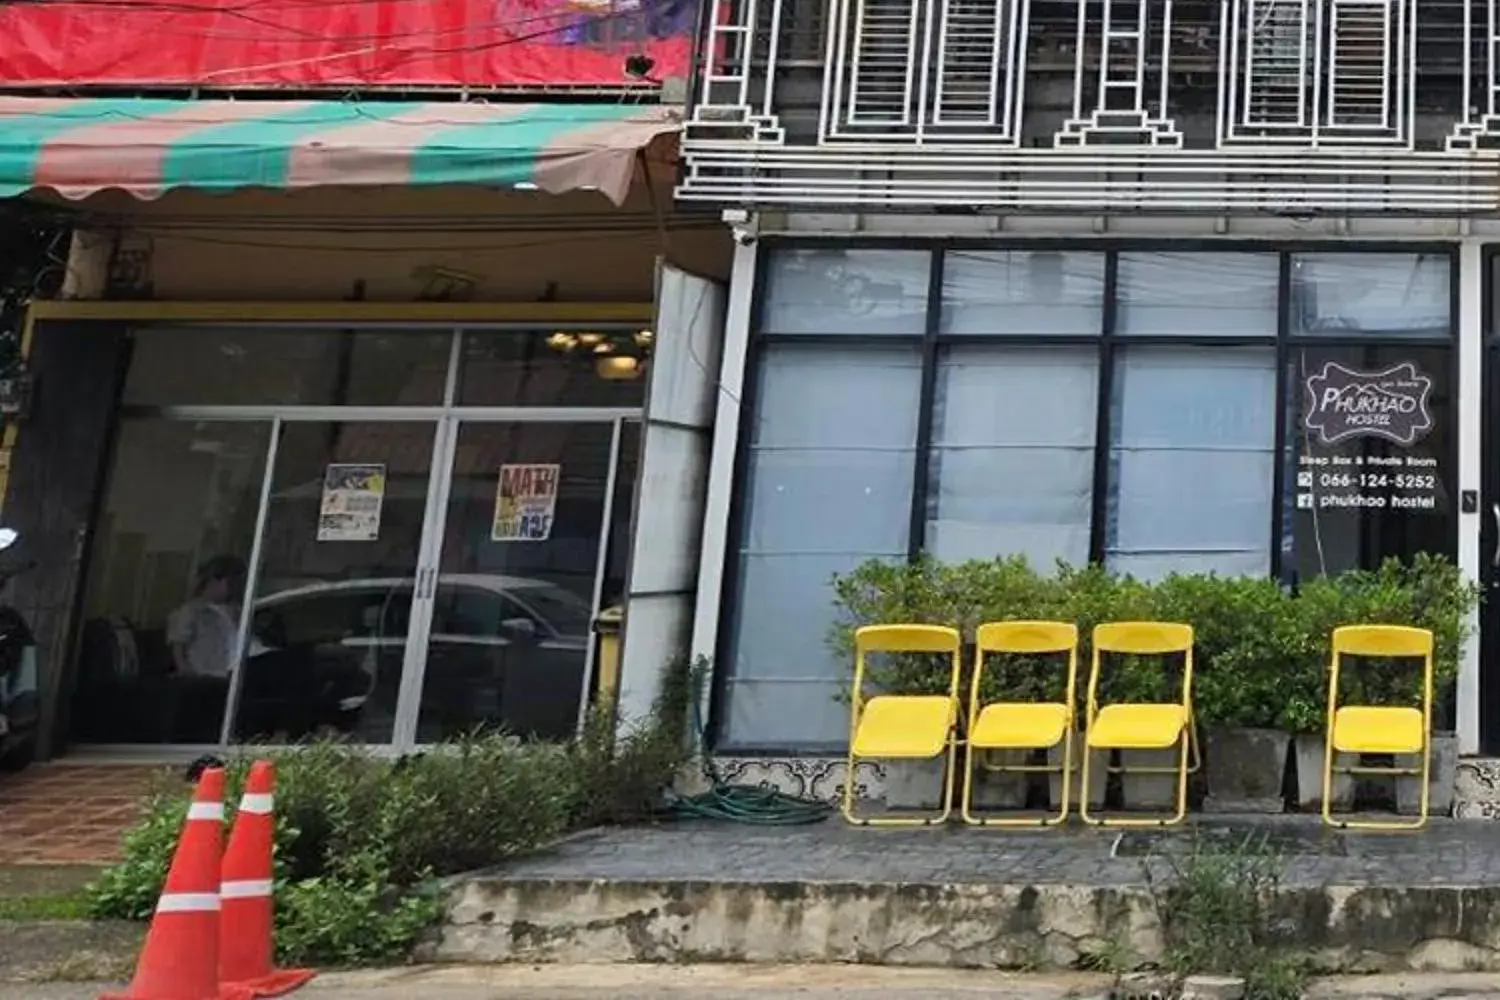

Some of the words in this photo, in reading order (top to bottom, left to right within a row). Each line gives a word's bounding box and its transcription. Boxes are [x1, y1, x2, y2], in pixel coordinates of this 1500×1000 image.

[1320, 387, 1417, 413] PHUKHAO
[1345, 413, 1391, 425] HOSTEL
[1320, 473, 1435, 489] 066-124-5252
[1320, 494, 1386, 508] phukhao
[1391, 495, 1436, 508] hostel
